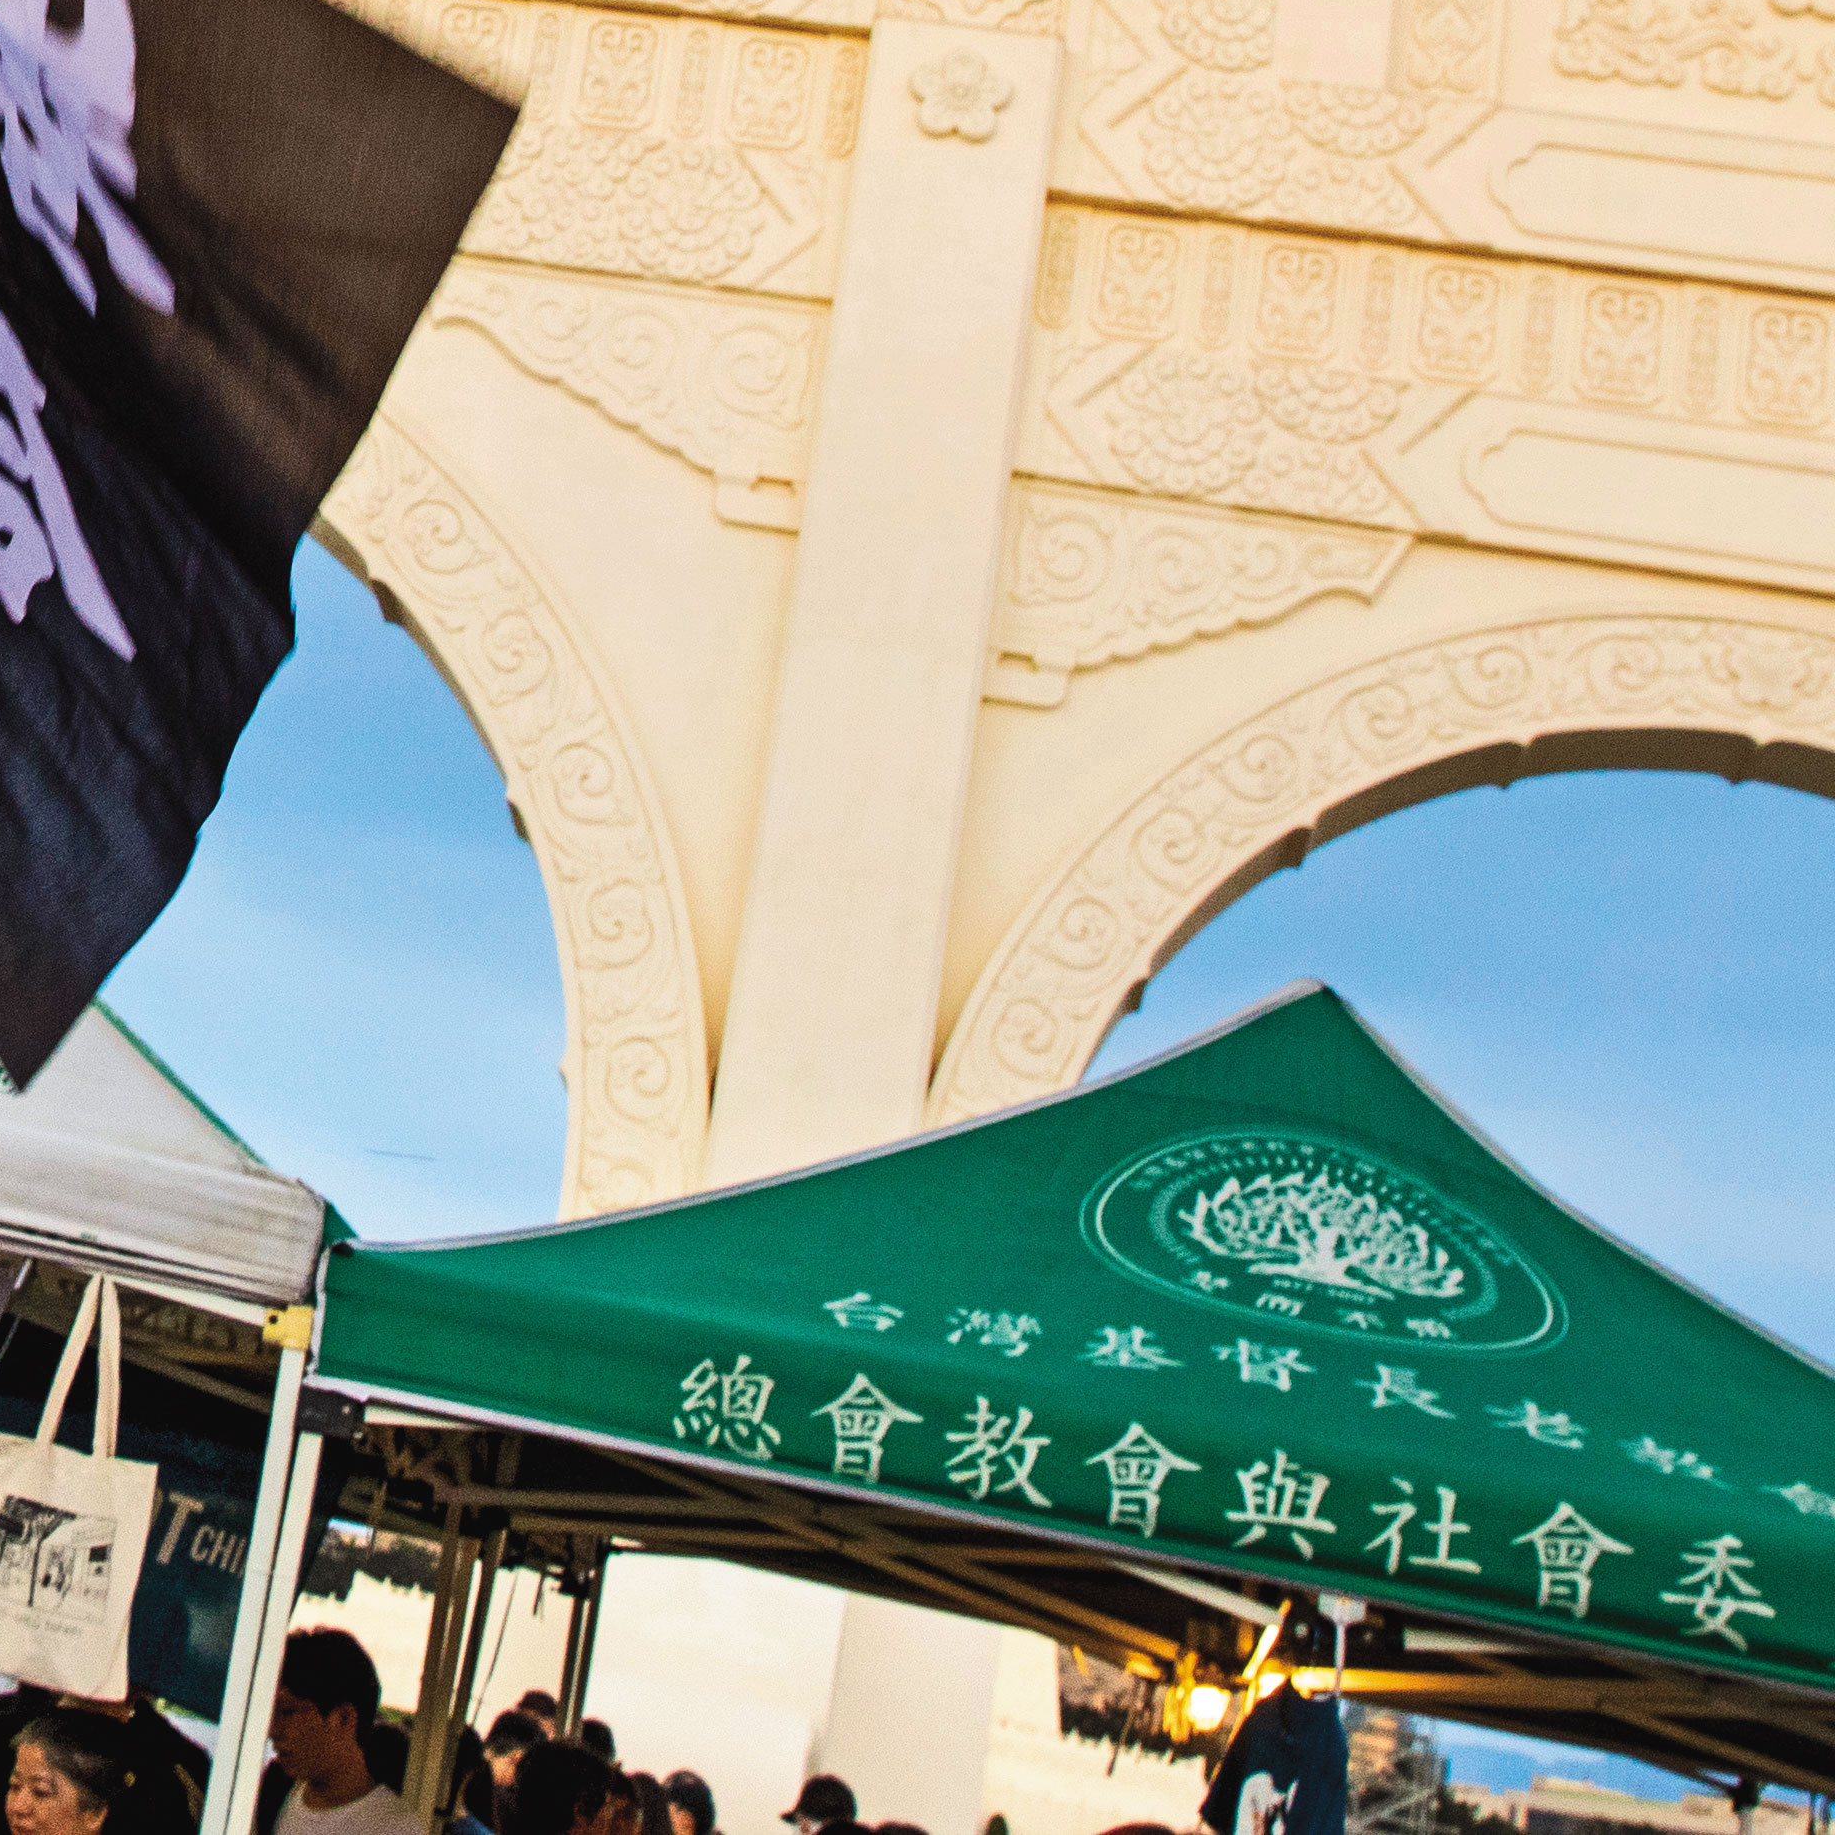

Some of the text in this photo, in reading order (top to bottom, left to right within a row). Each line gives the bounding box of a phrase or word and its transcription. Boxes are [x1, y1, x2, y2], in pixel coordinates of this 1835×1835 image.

[673, 1354, 1776, 1653] 總會教會與社會委
